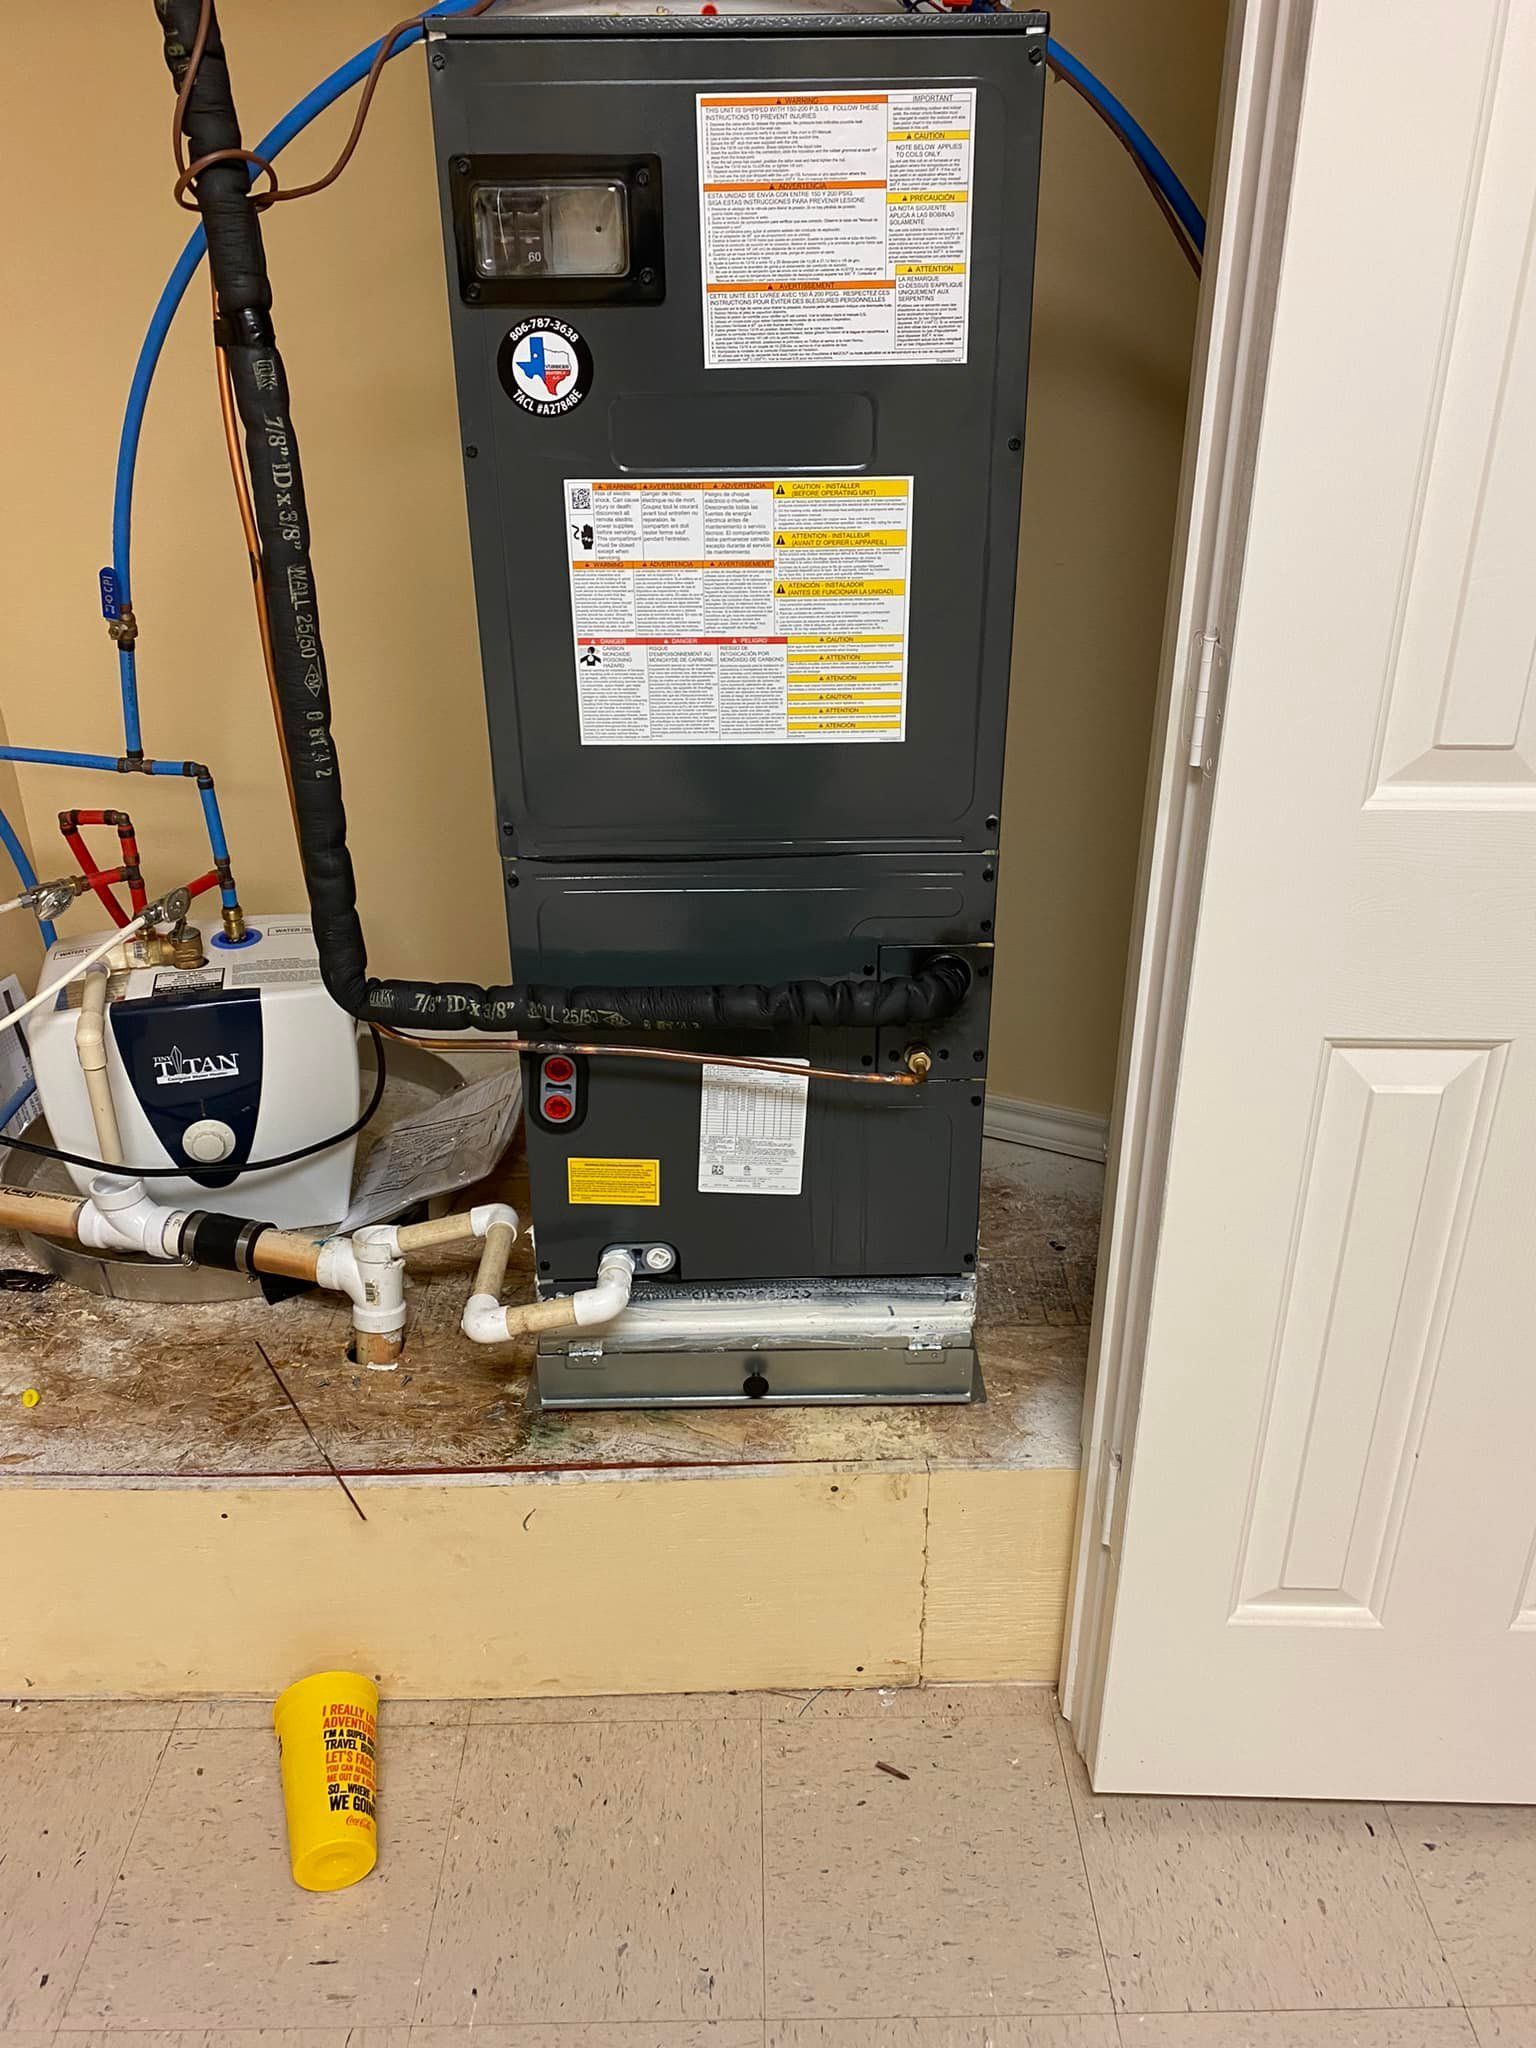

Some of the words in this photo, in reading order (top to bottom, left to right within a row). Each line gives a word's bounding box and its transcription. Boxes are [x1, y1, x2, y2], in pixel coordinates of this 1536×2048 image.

[912, 94, 954, 102] IMPORTANT
[914, 132, 945, 140] CAUTION
[528, 251, 542, 263] 60
[509, 317, 579, 343] 806-787-3638
[512, 388, 534, 412] TACL
[537, 388, 583, 415] #A27848E
[272, 463, 293, 489] ID
[792, 532, 827, 540] ATTENTION
[287, 565, 311, 611] WALL
[296, 614, 317, 658] 25/50
[446, 994, 467, 1013] ID
[152, 1055, 171, 1063] TINY
[330, 1703, 365, 1719] REALLY
[323, 1728, 337, 1740] I'M
[338, 1728, 344, 1738] A
[346, 1728, 367, 1742] SUPER
[324, 1738, 358, 1751] TRAVEL
[325, 1750, 353, 1764] LET'S
[341, 1764, 353, 1772] CAN
[339, 1773, 352, 1781] OUT
[329, 1794, 350, 1812] WE
